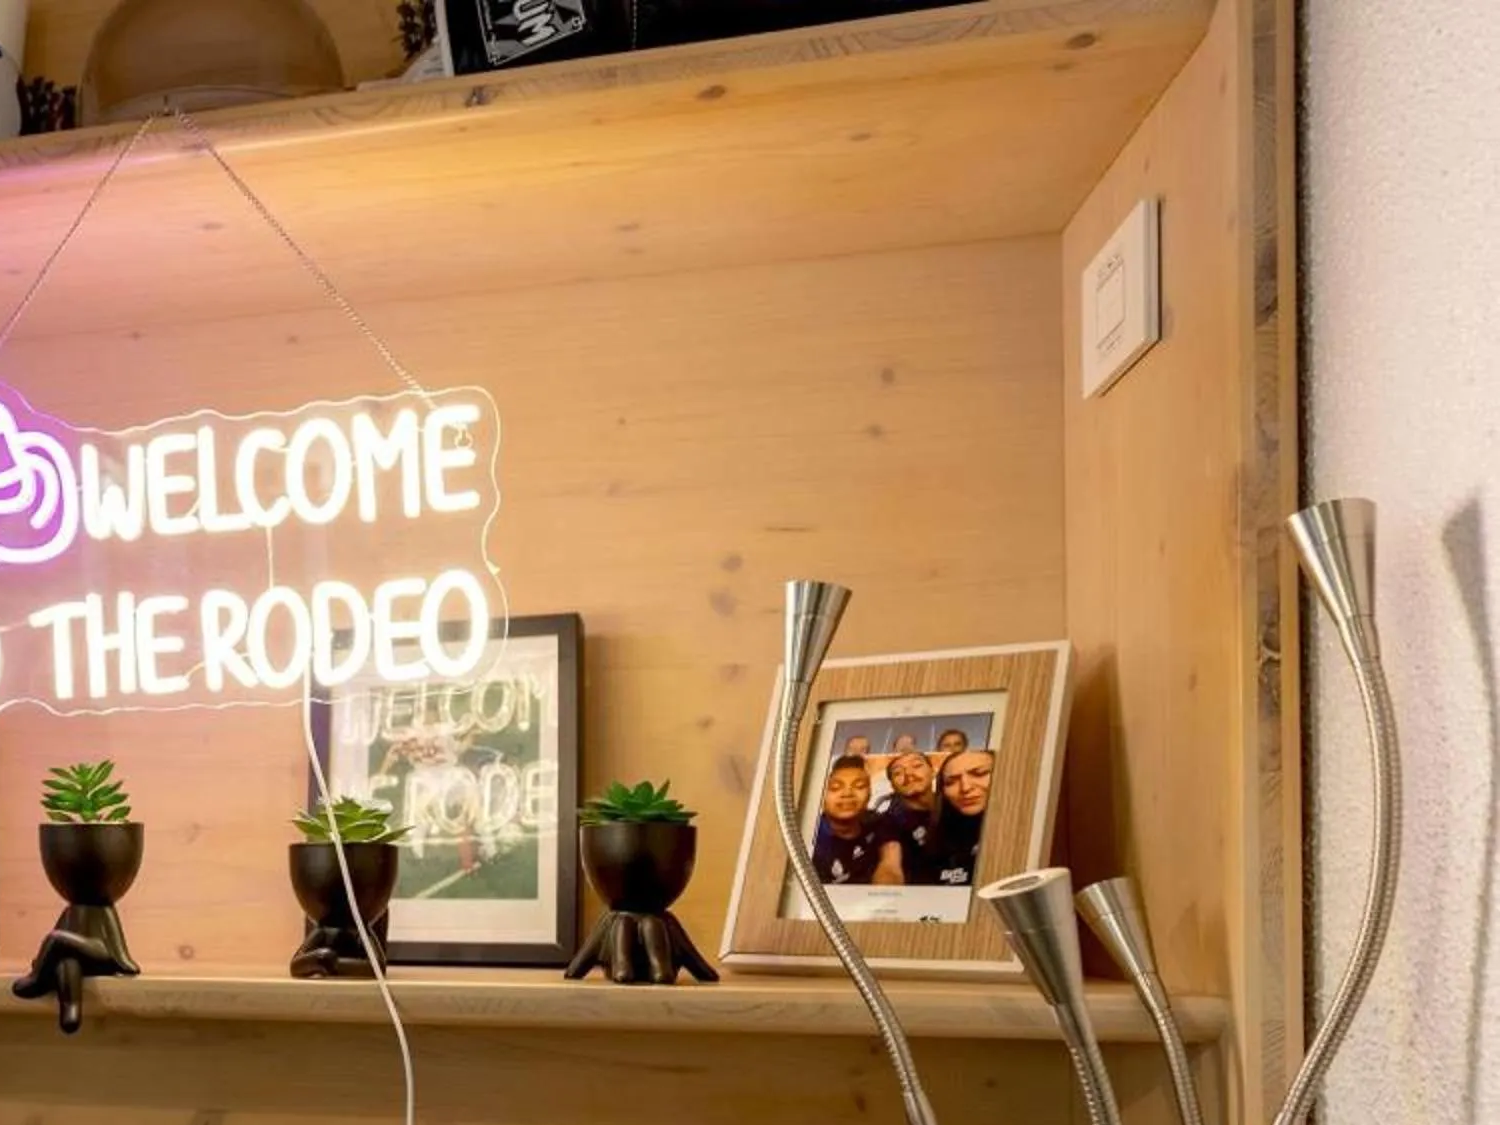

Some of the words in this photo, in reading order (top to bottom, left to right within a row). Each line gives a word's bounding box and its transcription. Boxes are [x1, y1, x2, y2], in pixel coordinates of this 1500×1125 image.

[81, 405, 481, 541] WELCOME
[30, 590, 190, 698] THE
[203, 569, 488, 692] RODEO
